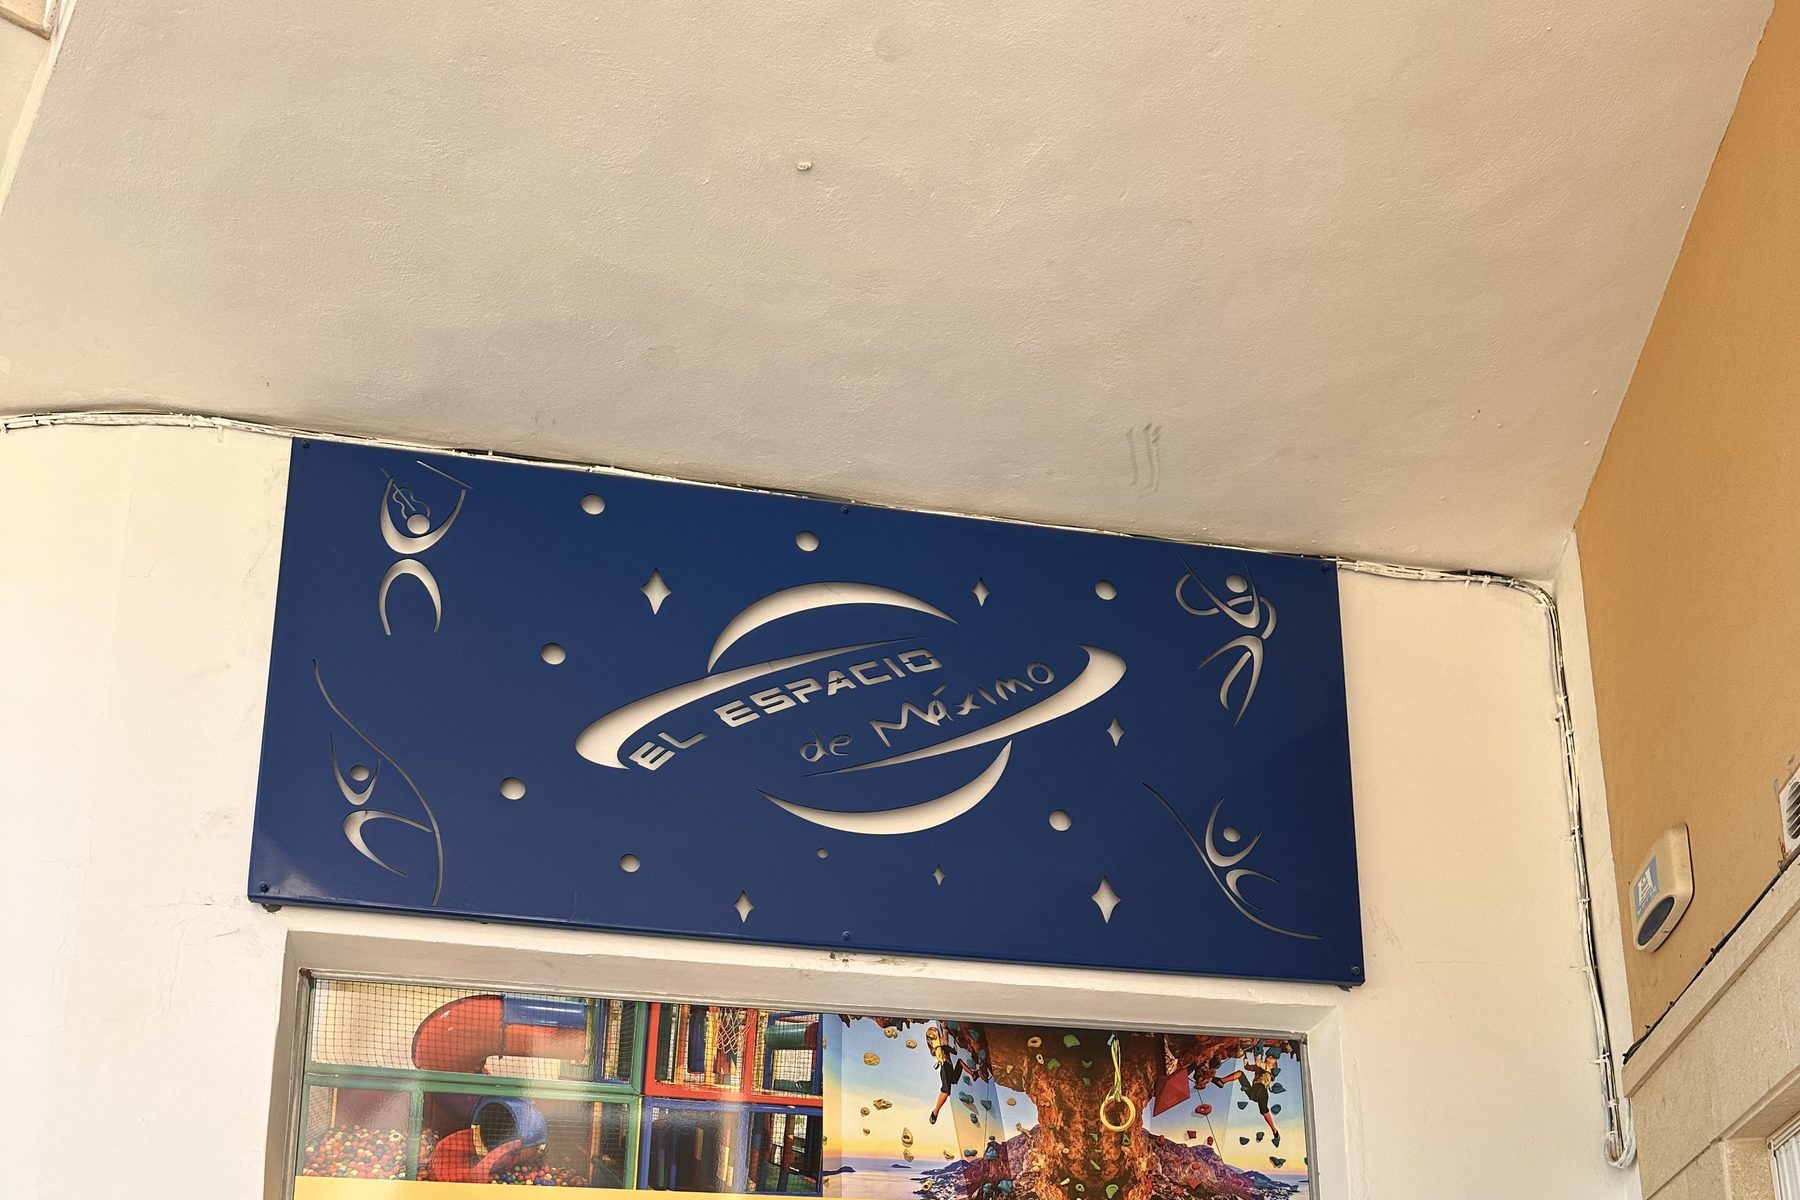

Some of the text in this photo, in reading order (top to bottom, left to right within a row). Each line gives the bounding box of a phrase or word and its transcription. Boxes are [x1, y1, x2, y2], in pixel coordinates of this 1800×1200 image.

[628, 647, 944, 772] EL ESPACIO
[799, 661, 1055, 763] de Máximo
